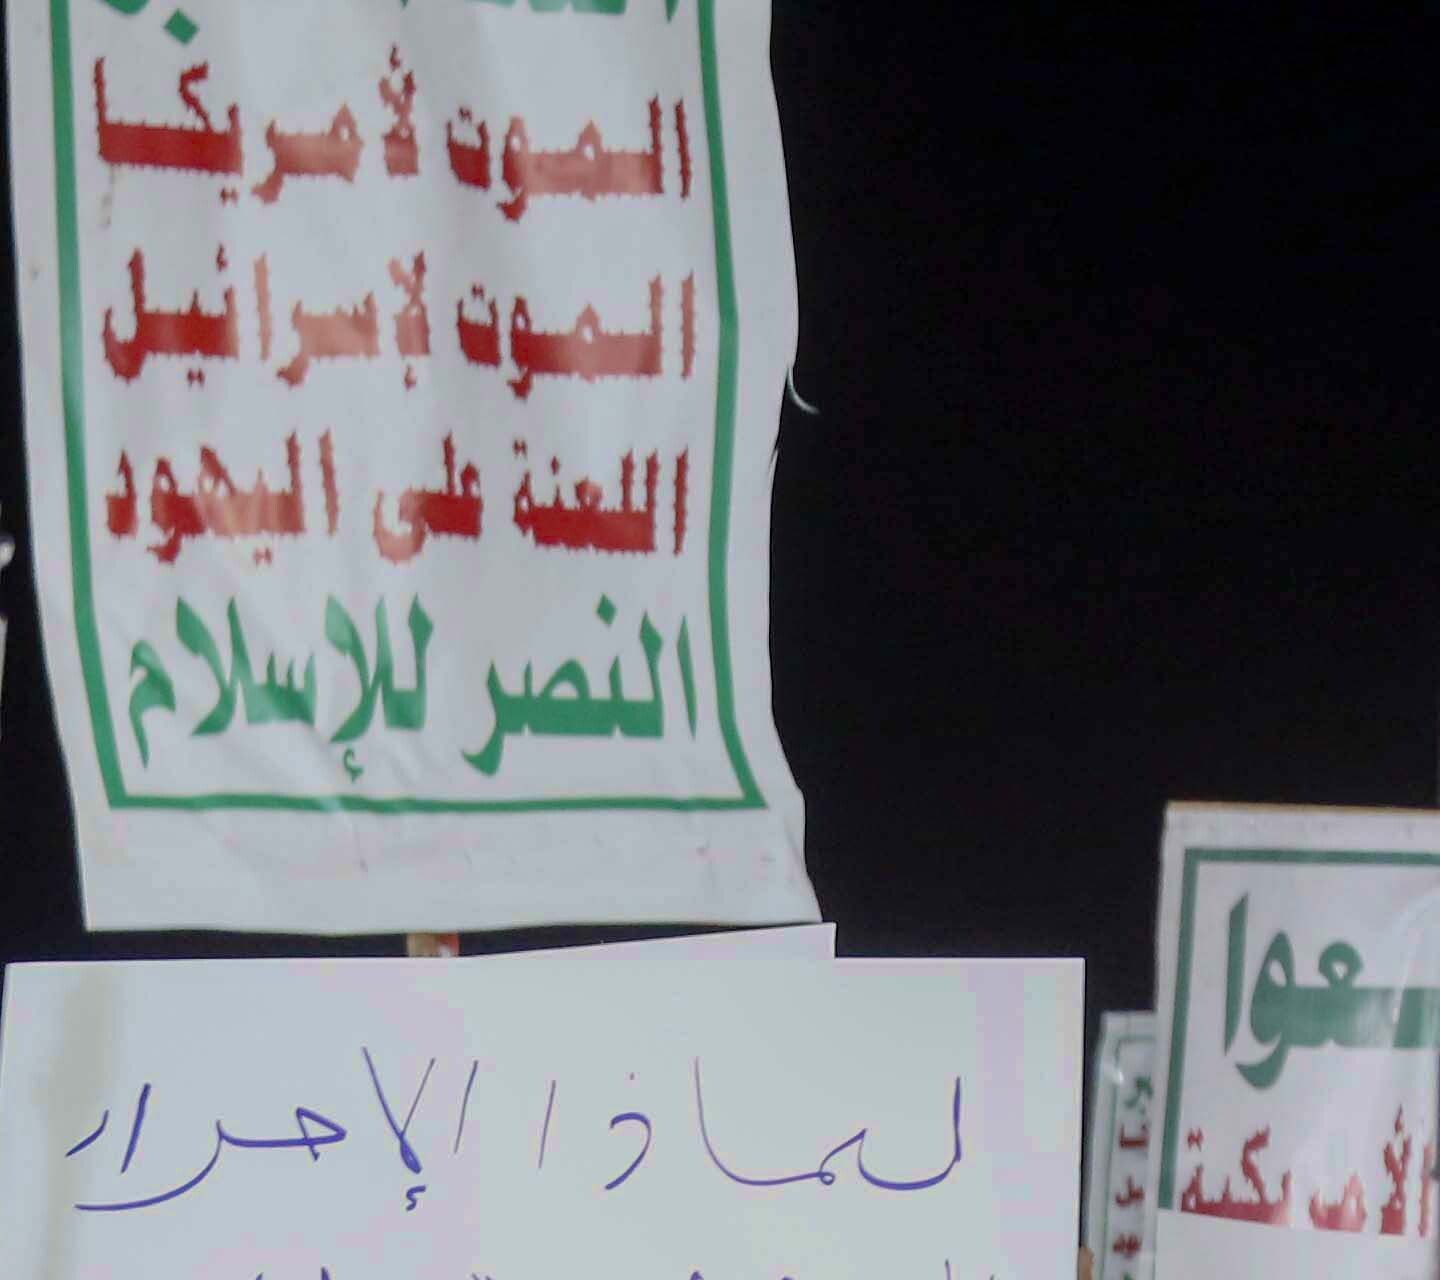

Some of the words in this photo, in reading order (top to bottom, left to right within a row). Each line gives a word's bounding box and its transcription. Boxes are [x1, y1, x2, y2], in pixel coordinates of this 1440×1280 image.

[93, 44, 420, 206] لأمريكا
[448, 95, 693, 222] الموت
[102, 244, 431, 389] لإسرائيل
[457, 271, 696, 401] الموت
[105, 427, 339, 567] اليهود
[372, 430, 483, 565] على
[513, 435, 691, 556] اللعنة
[128, 593, 434, 783] للإسلام
[462, 593, 698, 776] النصر
[538, 1057, 963, 1192] لماذا
